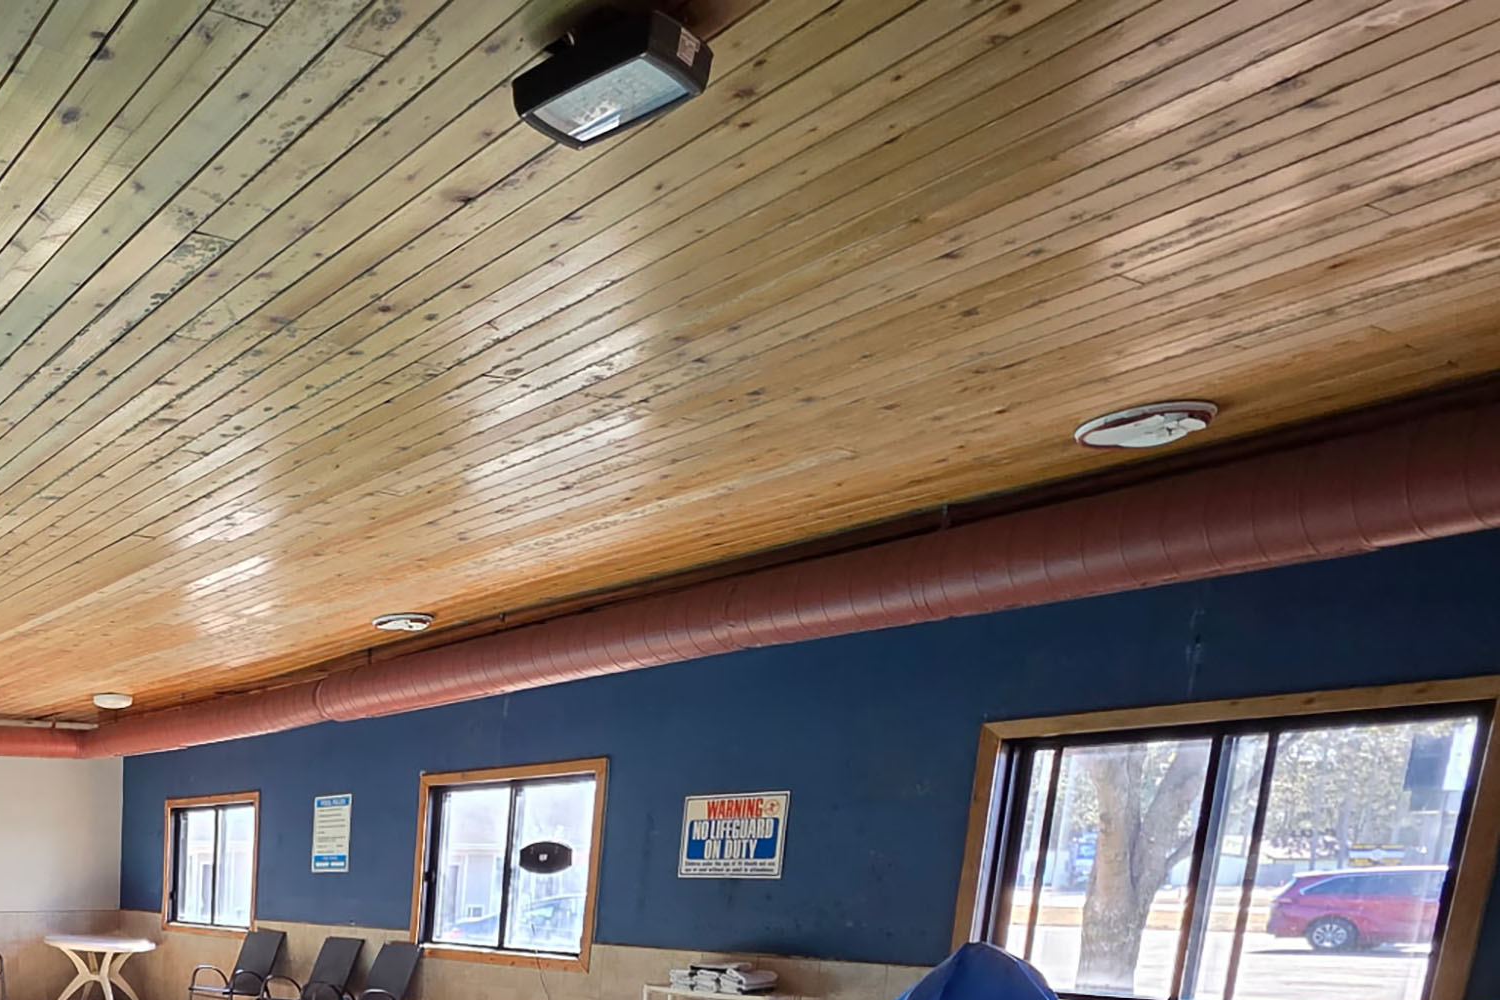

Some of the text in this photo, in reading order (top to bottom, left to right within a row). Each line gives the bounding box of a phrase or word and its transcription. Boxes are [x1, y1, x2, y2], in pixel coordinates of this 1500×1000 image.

[706, 797, 764, 820] WARNING
[692, 818, 775, 840] NO LIFEGUARD
[703, 839, 758, 859] ON DUTY
